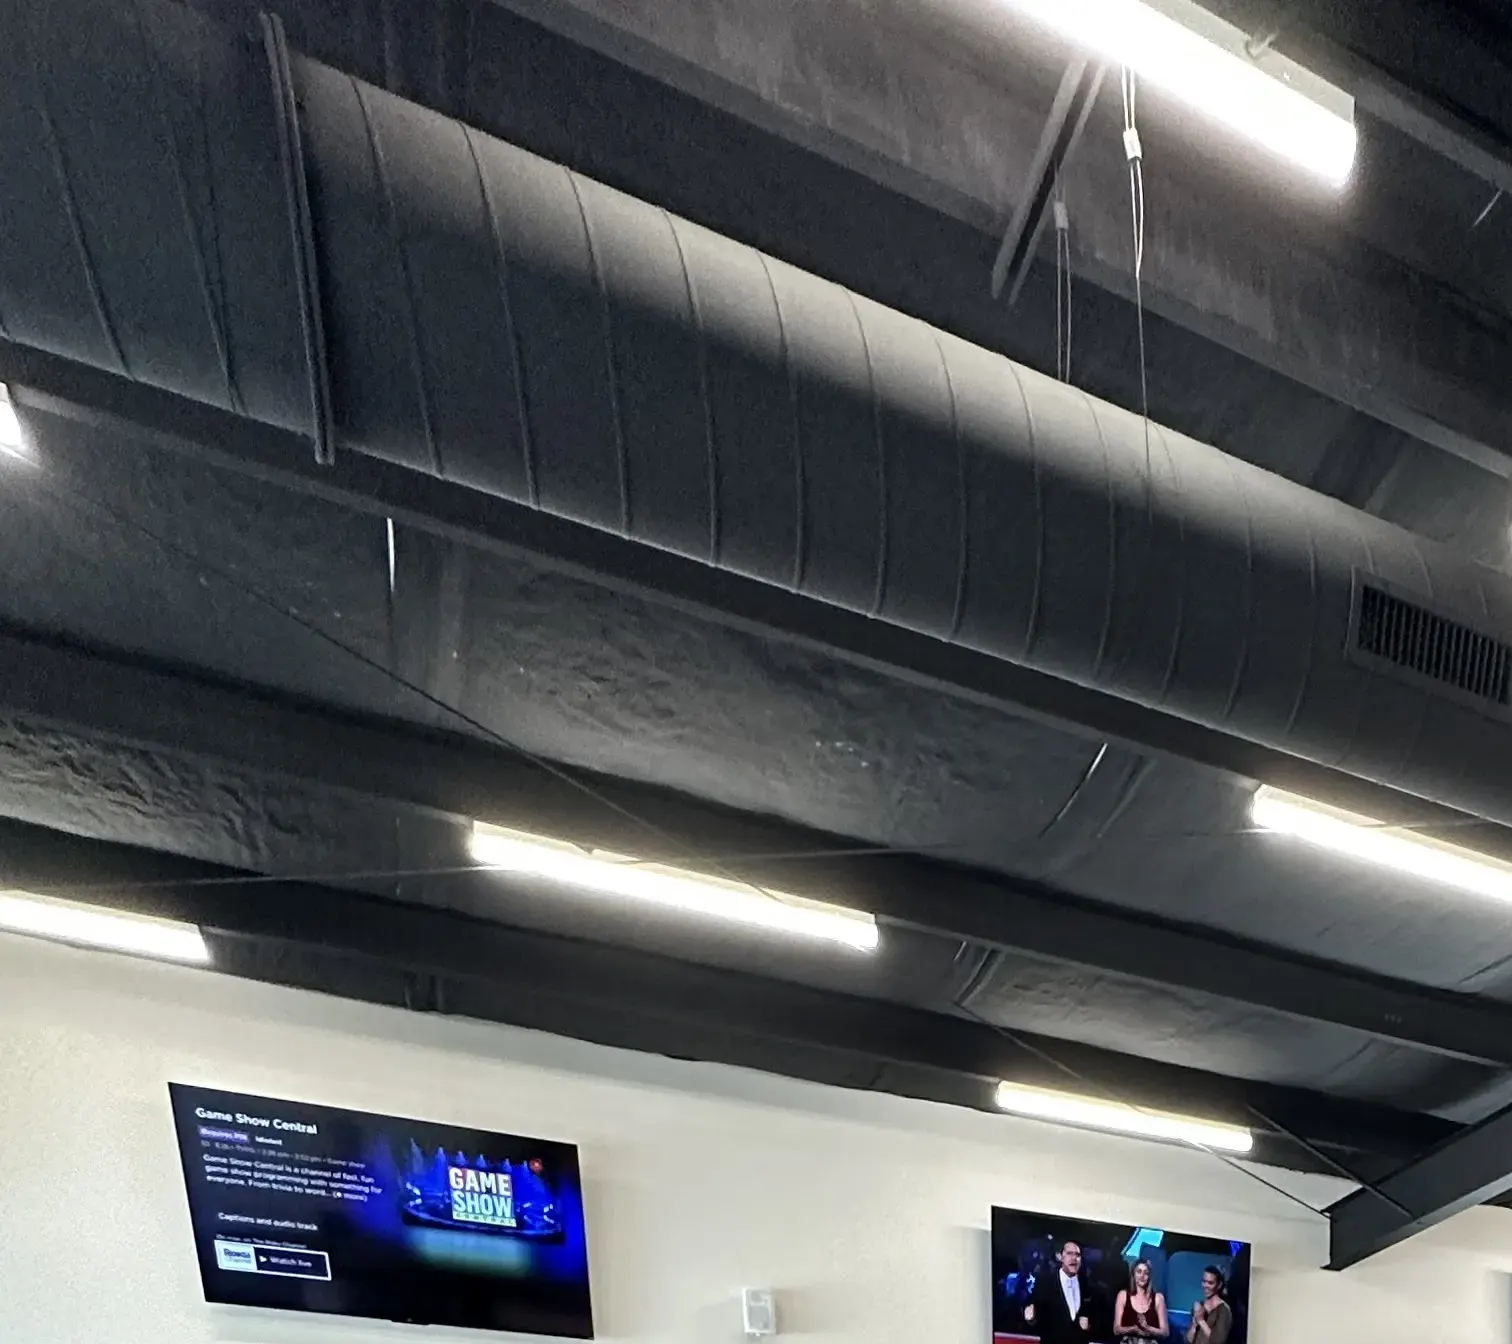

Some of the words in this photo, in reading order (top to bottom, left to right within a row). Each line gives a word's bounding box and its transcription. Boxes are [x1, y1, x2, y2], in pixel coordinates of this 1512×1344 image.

[195, 1107, 233, 1122] Game
[235, 1113, 270, 1128] Show
[273, 1119, 318, 1134] Central
[203, 1153, 228, 1163] Game
[229, 1157, 252, 1167] Show
[254, 1161, 284, 1171] Central
[205, 1165, 228, 1174] game
[230, 1168, 252, 1177] show
[449, 1166, 512, 1197] GAME
[452, 1190, 514, 1218] SHOW
